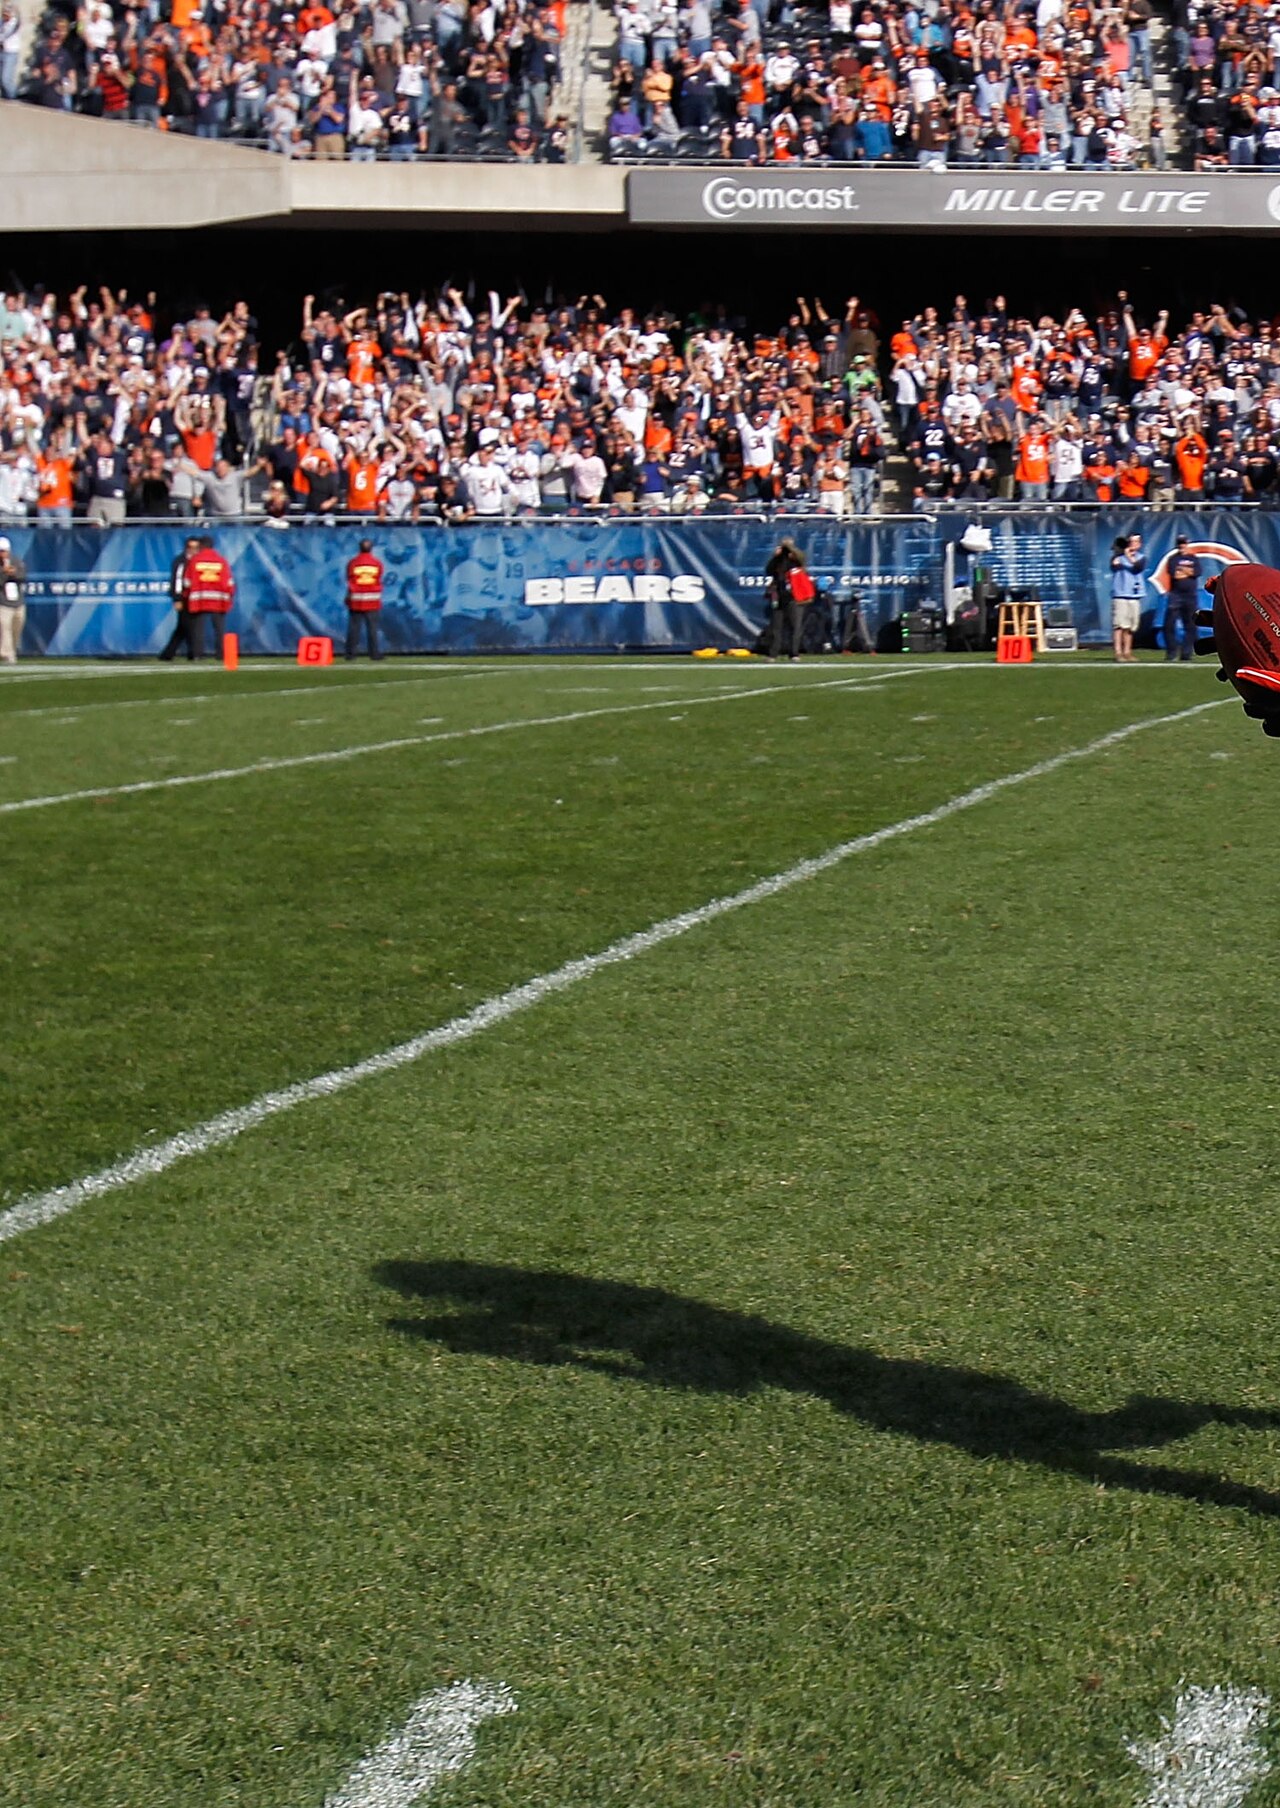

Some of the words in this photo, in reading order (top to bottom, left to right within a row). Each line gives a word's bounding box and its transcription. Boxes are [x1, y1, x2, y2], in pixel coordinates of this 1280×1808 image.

[944, 189, 1104, 213] MILLER
[1117, 190, 1210, 214] LITE
[924, 429, 945, 446] 22
[355, 472, 367, 490] 6
[569, 558, 661, 572] CHICAGO
[50, 581, 109, 595] WORLD
[840, 575, 930, 585] CHAMPIONS
[525, 575, 706, 606] BEARS
[1245, 592, 1270, 622] NATIONAL
[306, 642, 321, 661] G
[1003, 640, 1022, 659] 10
[1253, 628, 1279, 666] Wilson
